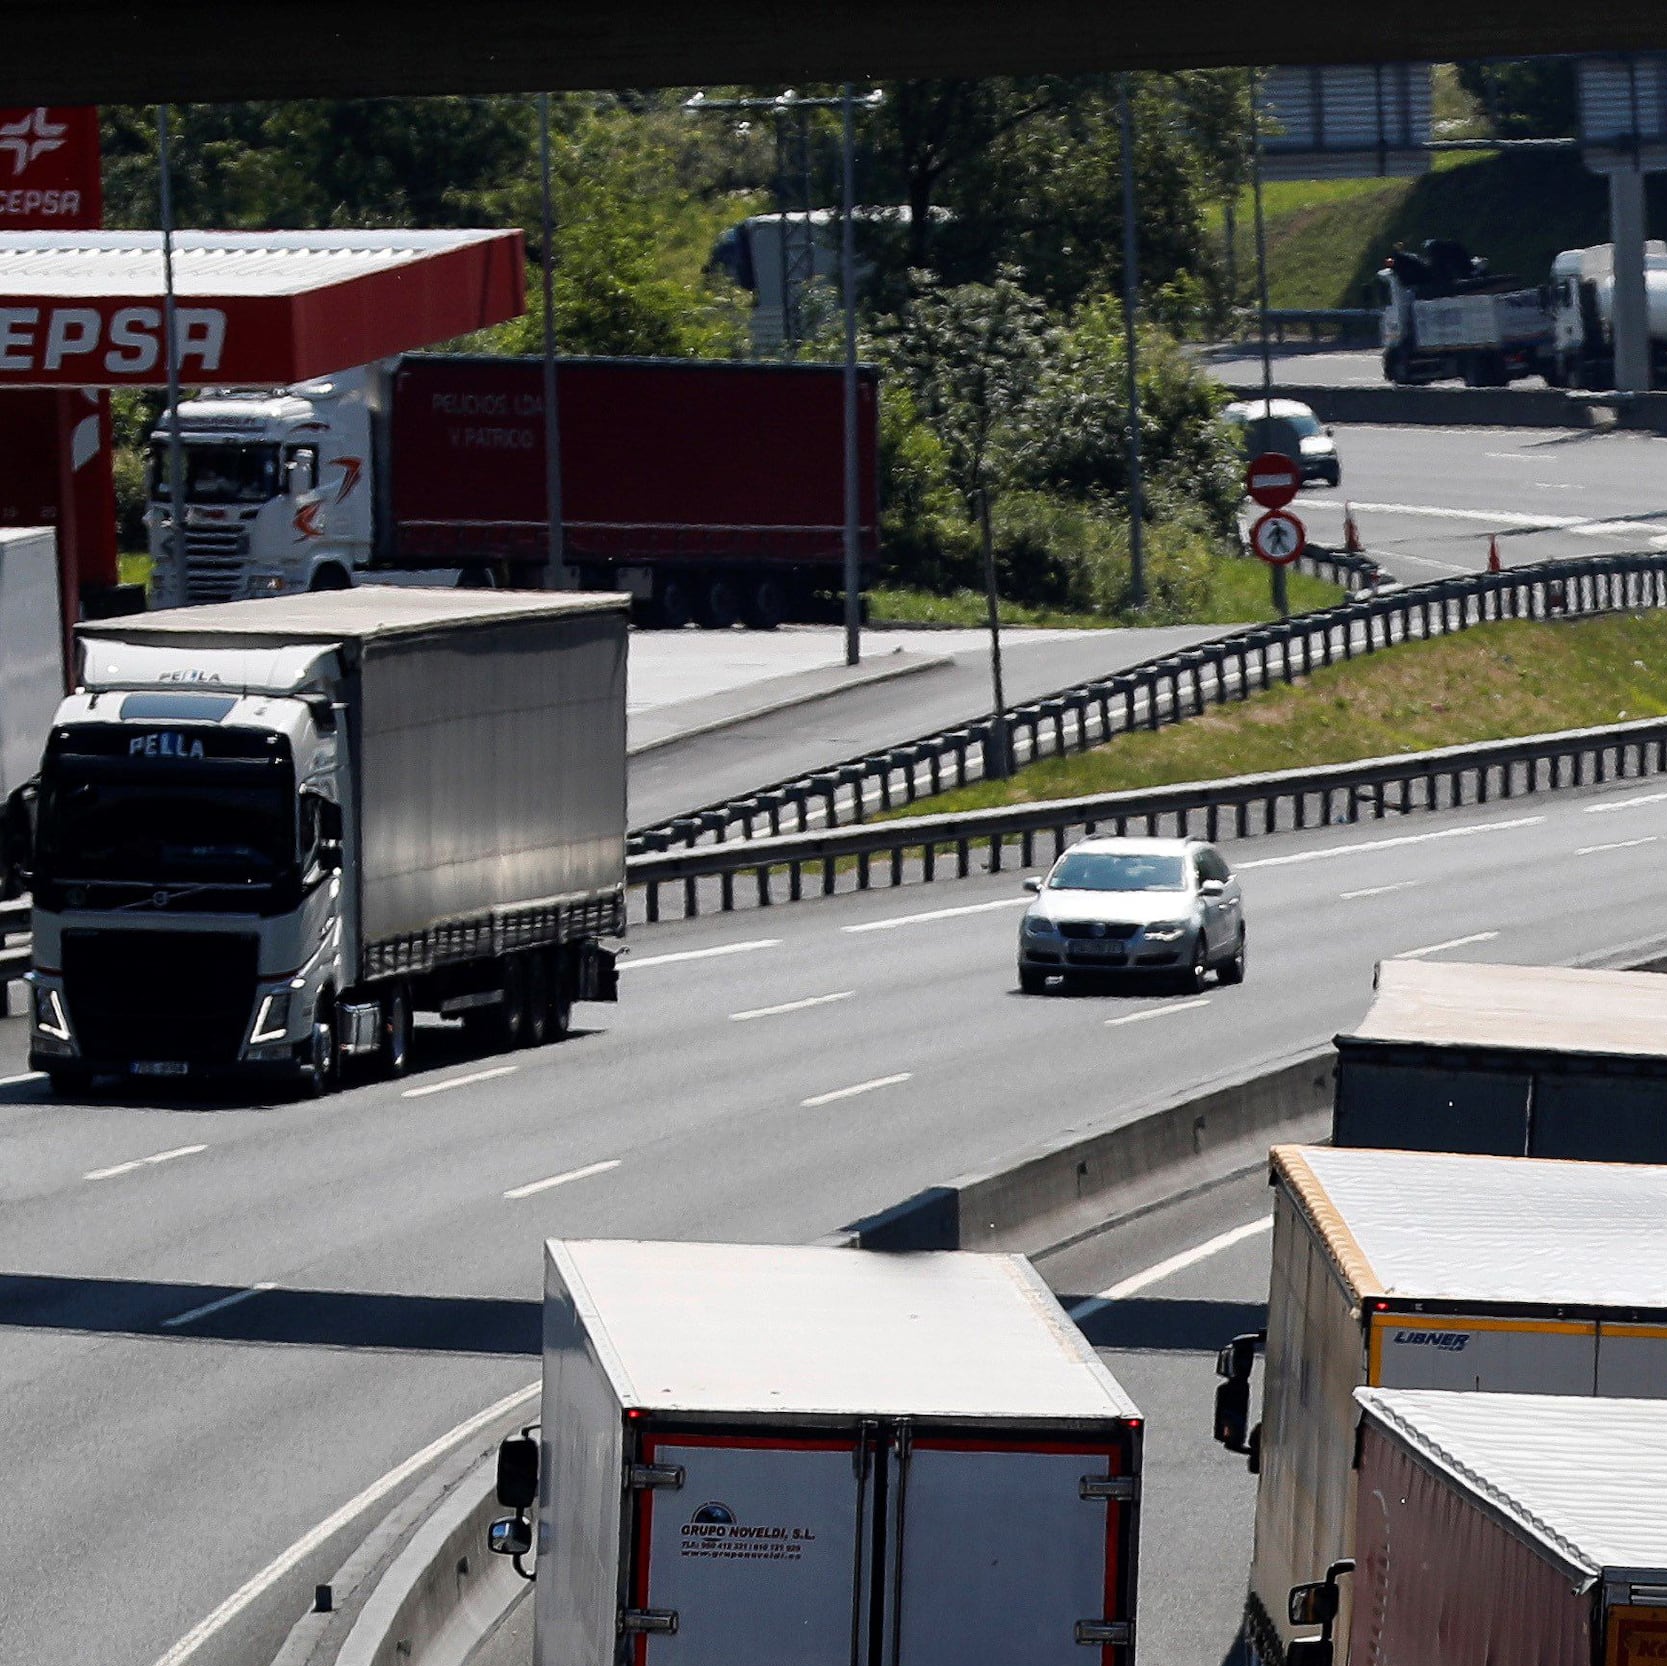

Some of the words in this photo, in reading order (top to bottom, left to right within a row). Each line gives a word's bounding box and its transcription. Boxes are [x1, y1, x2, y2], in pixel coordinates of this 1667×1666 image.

[128, 731, 205, 758] PELLA
[1394, 1331, 1470, 1346] LIBNER
[681, 1525, 726, 1537] GRUPO
[729, 1527, 789, 1540] NOVELDI,
[792, 1528, 816, 1541] S.L.
